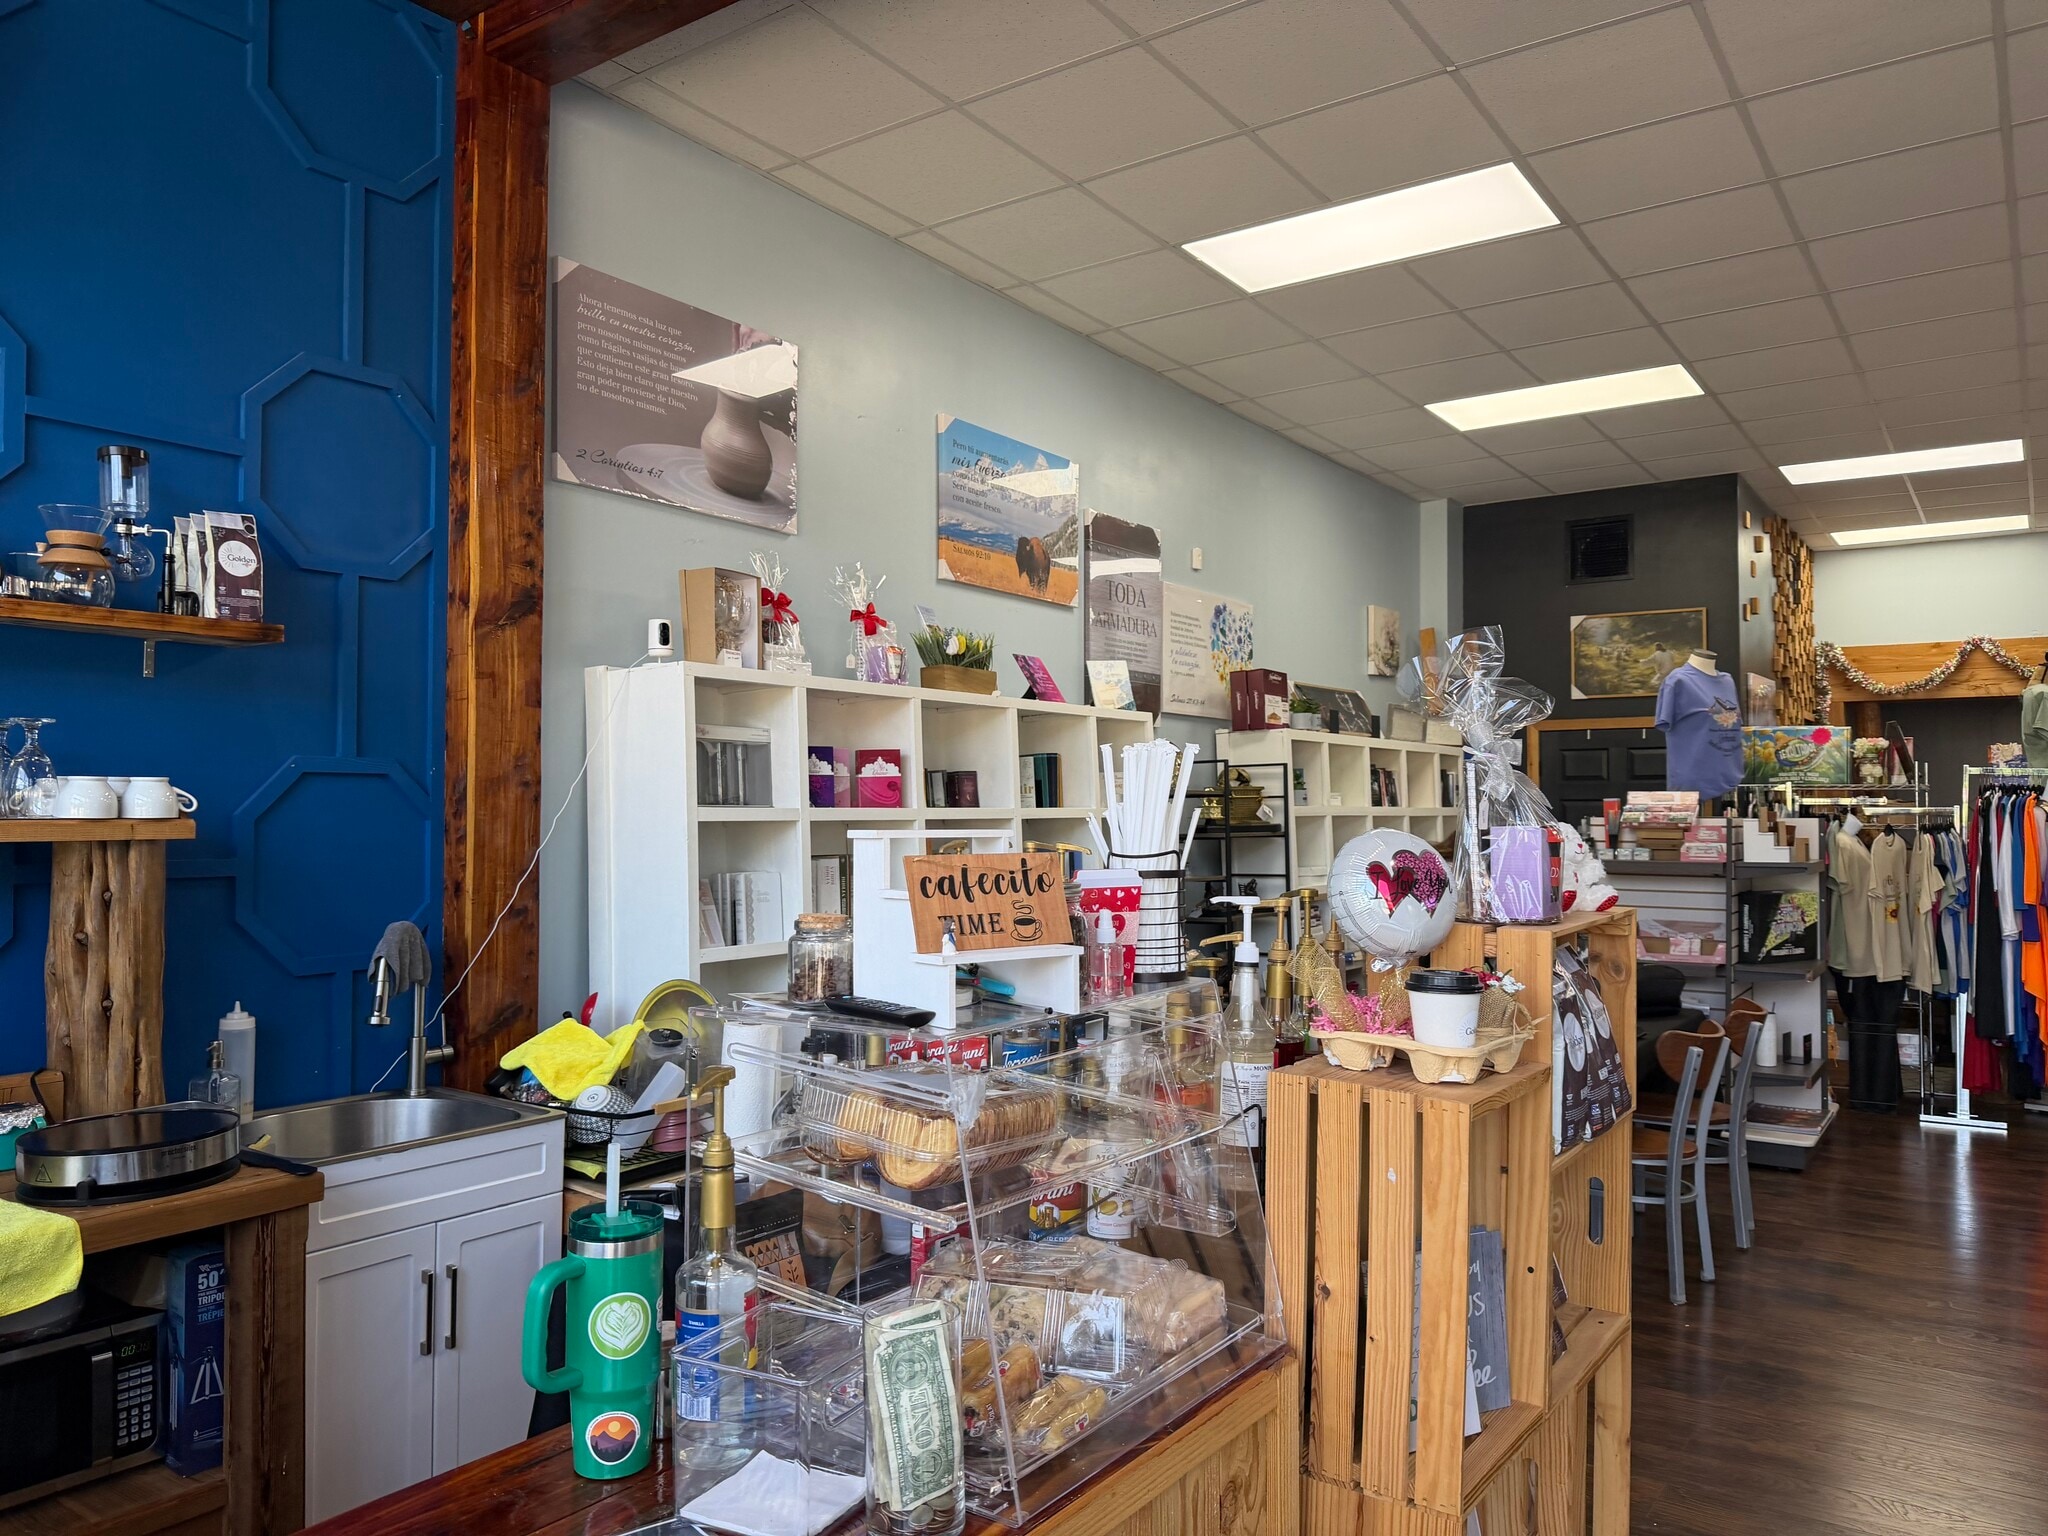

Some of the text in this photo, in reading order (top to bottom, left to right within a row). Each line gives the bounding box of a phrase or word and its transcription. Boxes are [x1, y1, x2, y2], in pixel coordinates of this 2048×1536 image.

[577, 303, 695, 353] brilla en nuestro corazón.
[578, 293, 682, 337] Ahora tenemos esta luz que
[577, 321, 687, 363] pero nosotros mismos somos
[577, 333, 600, 346] como
[601, 340, 631, 356] frágiles
[632, 351, 658, 366] vasijas
[659, 360, 669, 369] de
[577, 345, 695, 389] que contienen este gran tesoro.
[577, 356, 698, 401] Esto deja bien claro que nuestro
[577, 370, 687, 410] gran poder proviene de Dios,
[577, 382, 668, 415] no de nosotros mismos.
[576, 449, 665, 479] 2 Corintios 4:7
[951, 456, 1007, 480] mis fuerza
[952, 438, 1009, 466] Pero tú aumentarás
[952, 480, 967, 492] Seré
[967, 486, 988, 499] ungido
[952, 494, 965, 503] con
[965, 498, 982, 507] aceite
[227, 553, 256, 564] Golden
[1106, 580, 1146, 608] TODA
[1095, 612, 1157, 638] ARMADURA
[919, 857, 1055, 903] cafecito
[1370, 871, 1384, 900] I
[1387, 868, 1420, 903] Love
[196, 1308, 225, 1323] TRÉPIE
[880, 1364, 894, 1402] AMERICA
[891, 1413, 901, 1443] STATES
[907, 1389, 935, 1450] ONE
[894, 1442, 905, 1472] UNITED
